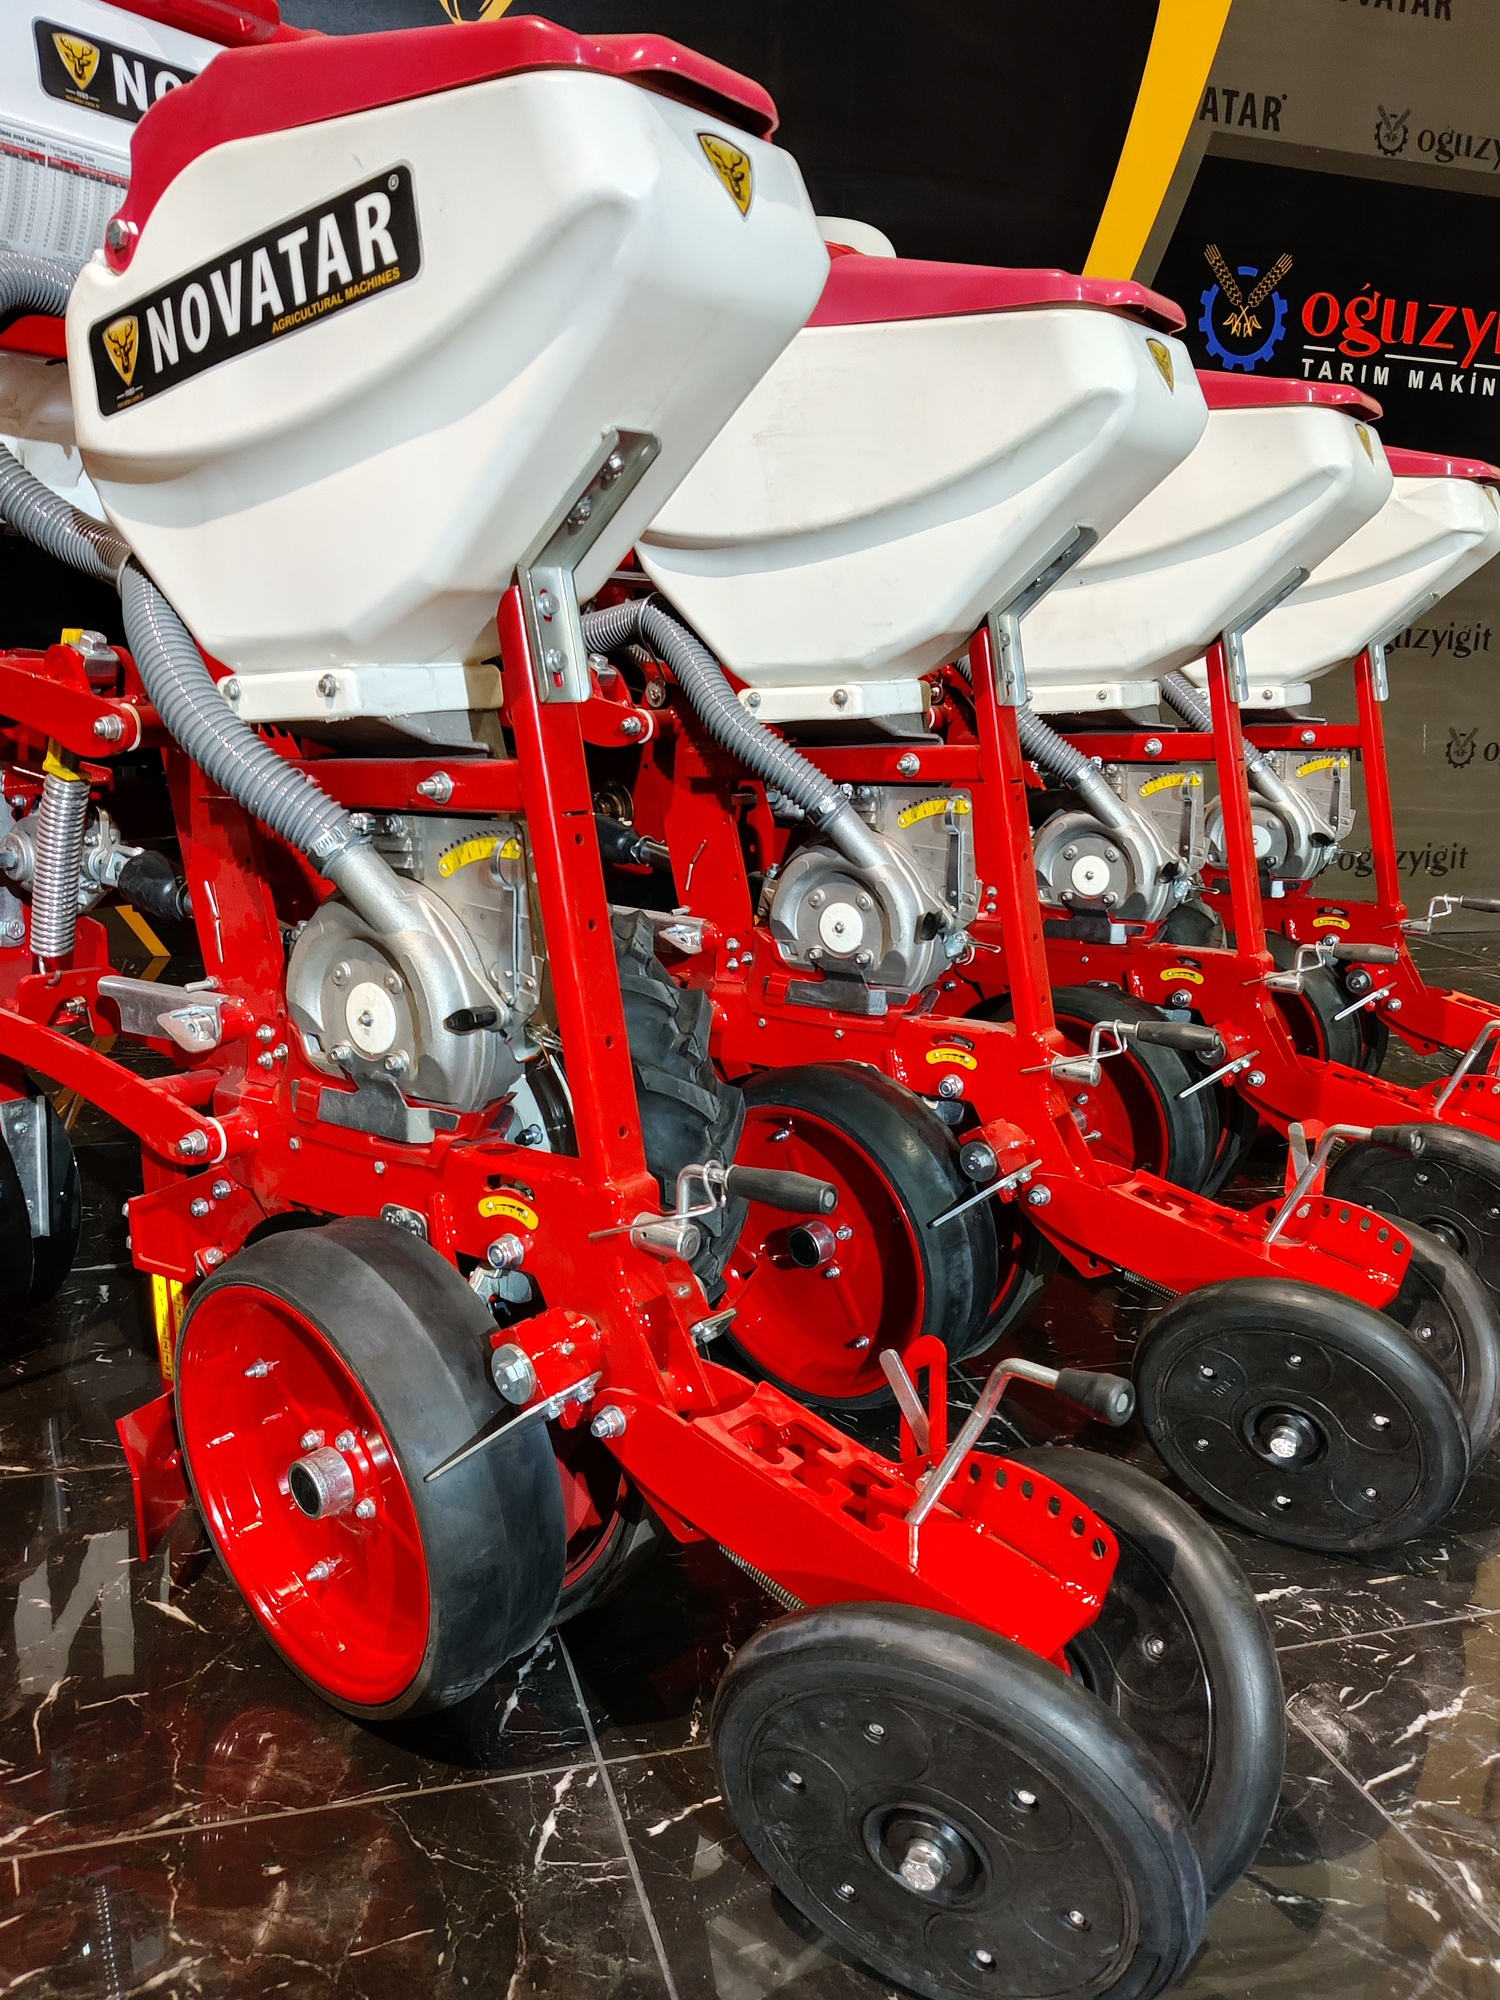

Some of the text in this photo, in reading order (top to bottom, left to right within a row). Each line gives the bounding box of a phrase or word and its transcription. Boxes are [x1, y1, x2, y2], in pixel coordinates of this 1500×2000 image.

[146, 191, 398, 374] NOVATAR
[272, 266, 400, 334] AGRICULTURAL MACHINES
[1302, 358, 1496, 397] TARIM MAKİN
[163, 1340, 169, 1350] 2
